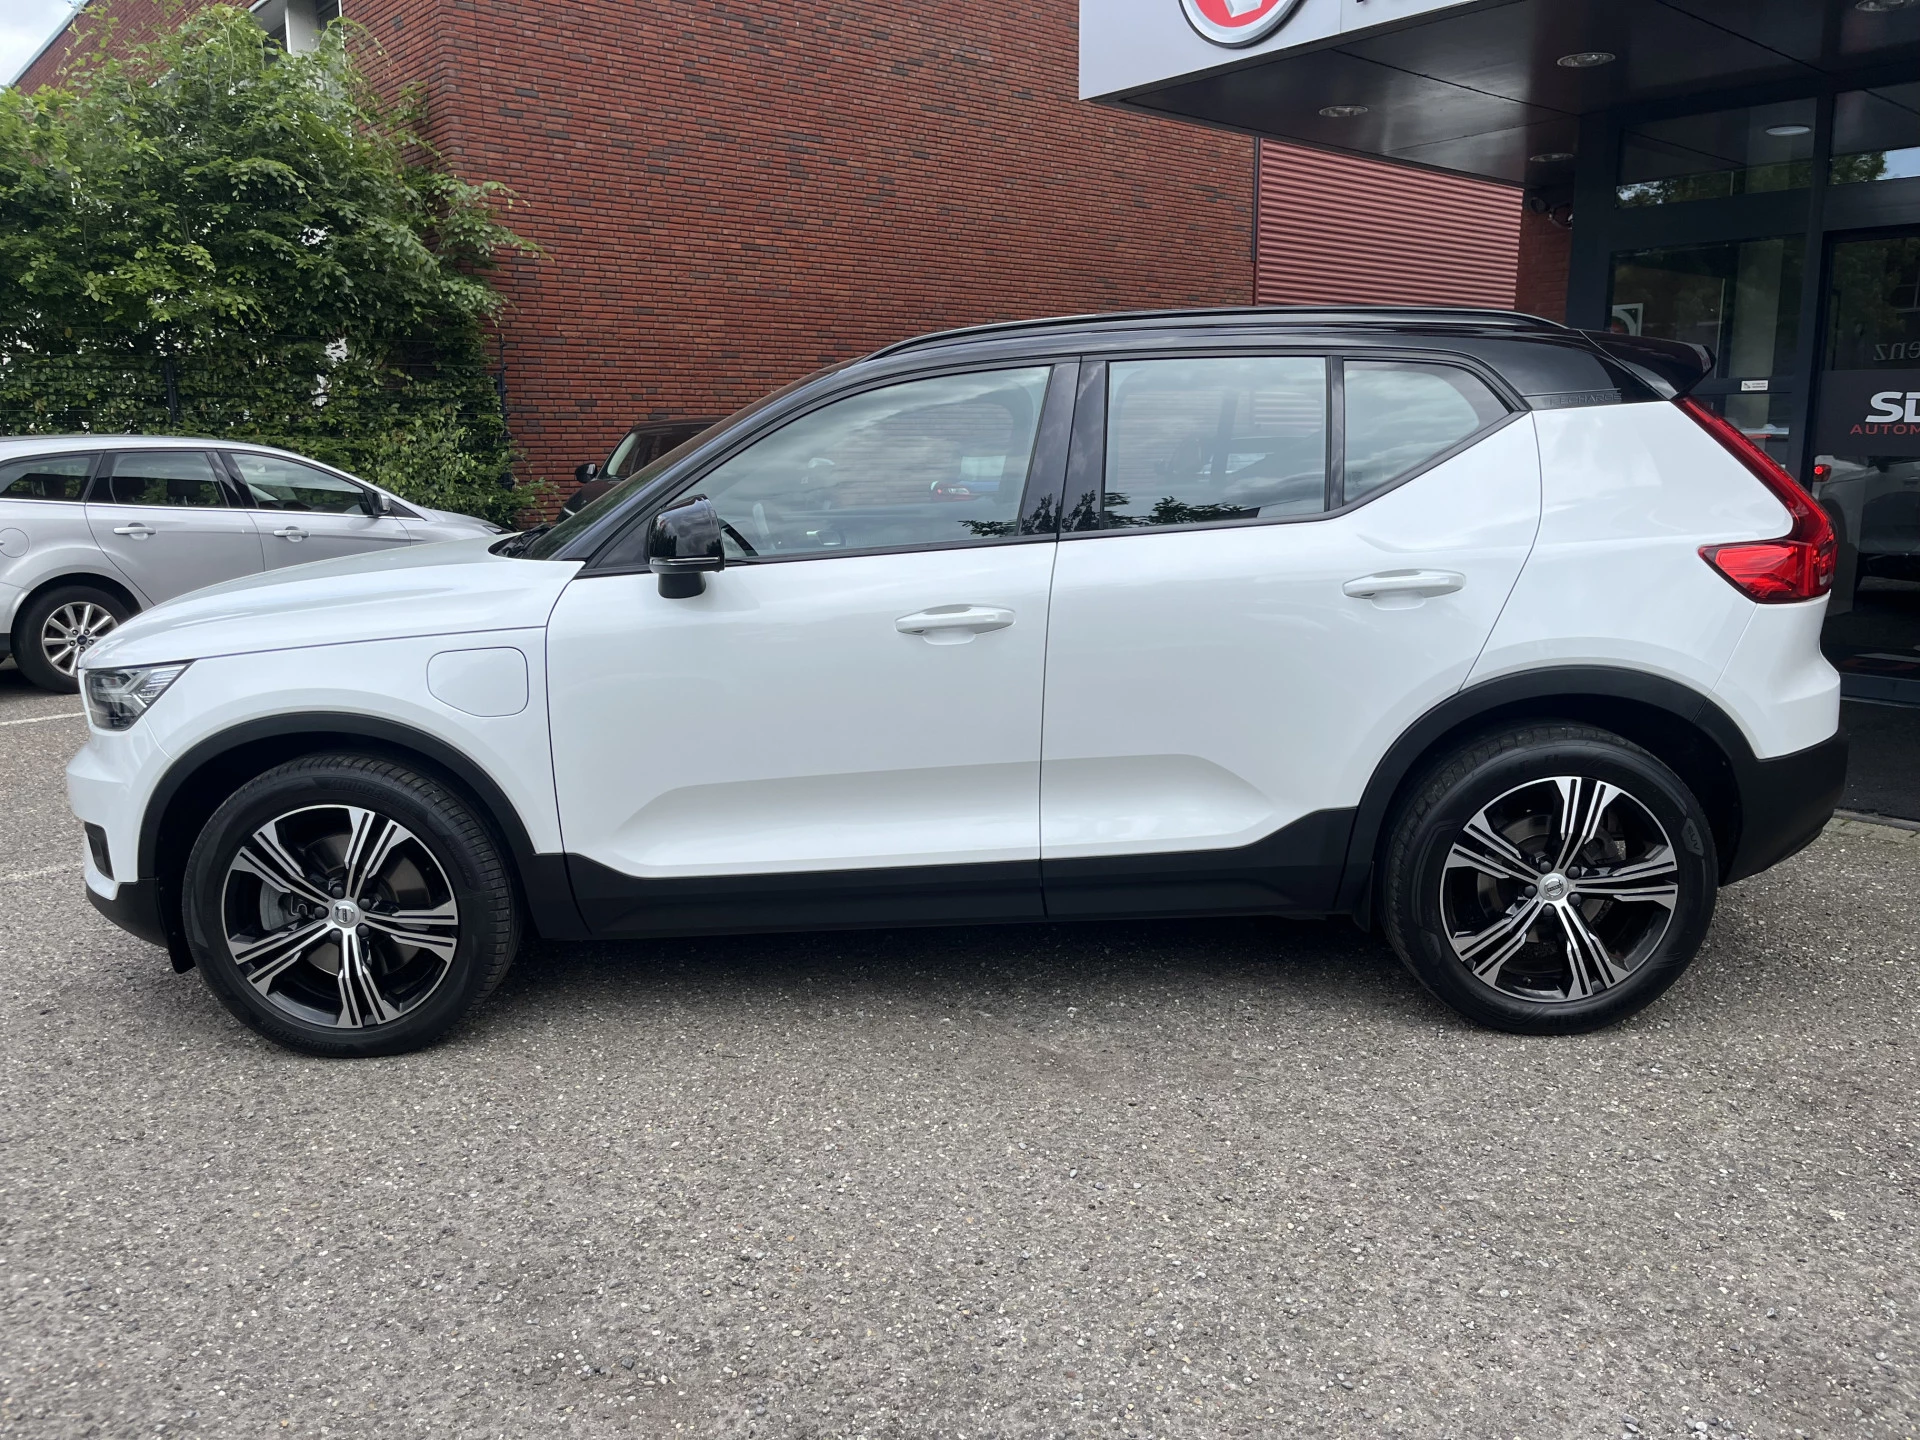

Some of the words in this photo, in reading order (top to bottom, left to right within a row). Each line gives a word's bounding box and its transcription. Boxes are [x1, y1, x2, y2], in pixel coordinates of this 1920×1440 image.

[1550, 393, 1622, 406] RECHARGE
[1850, 424, 1920, 435] AUTOM
[1687, 827, 1701, 851] SUV
